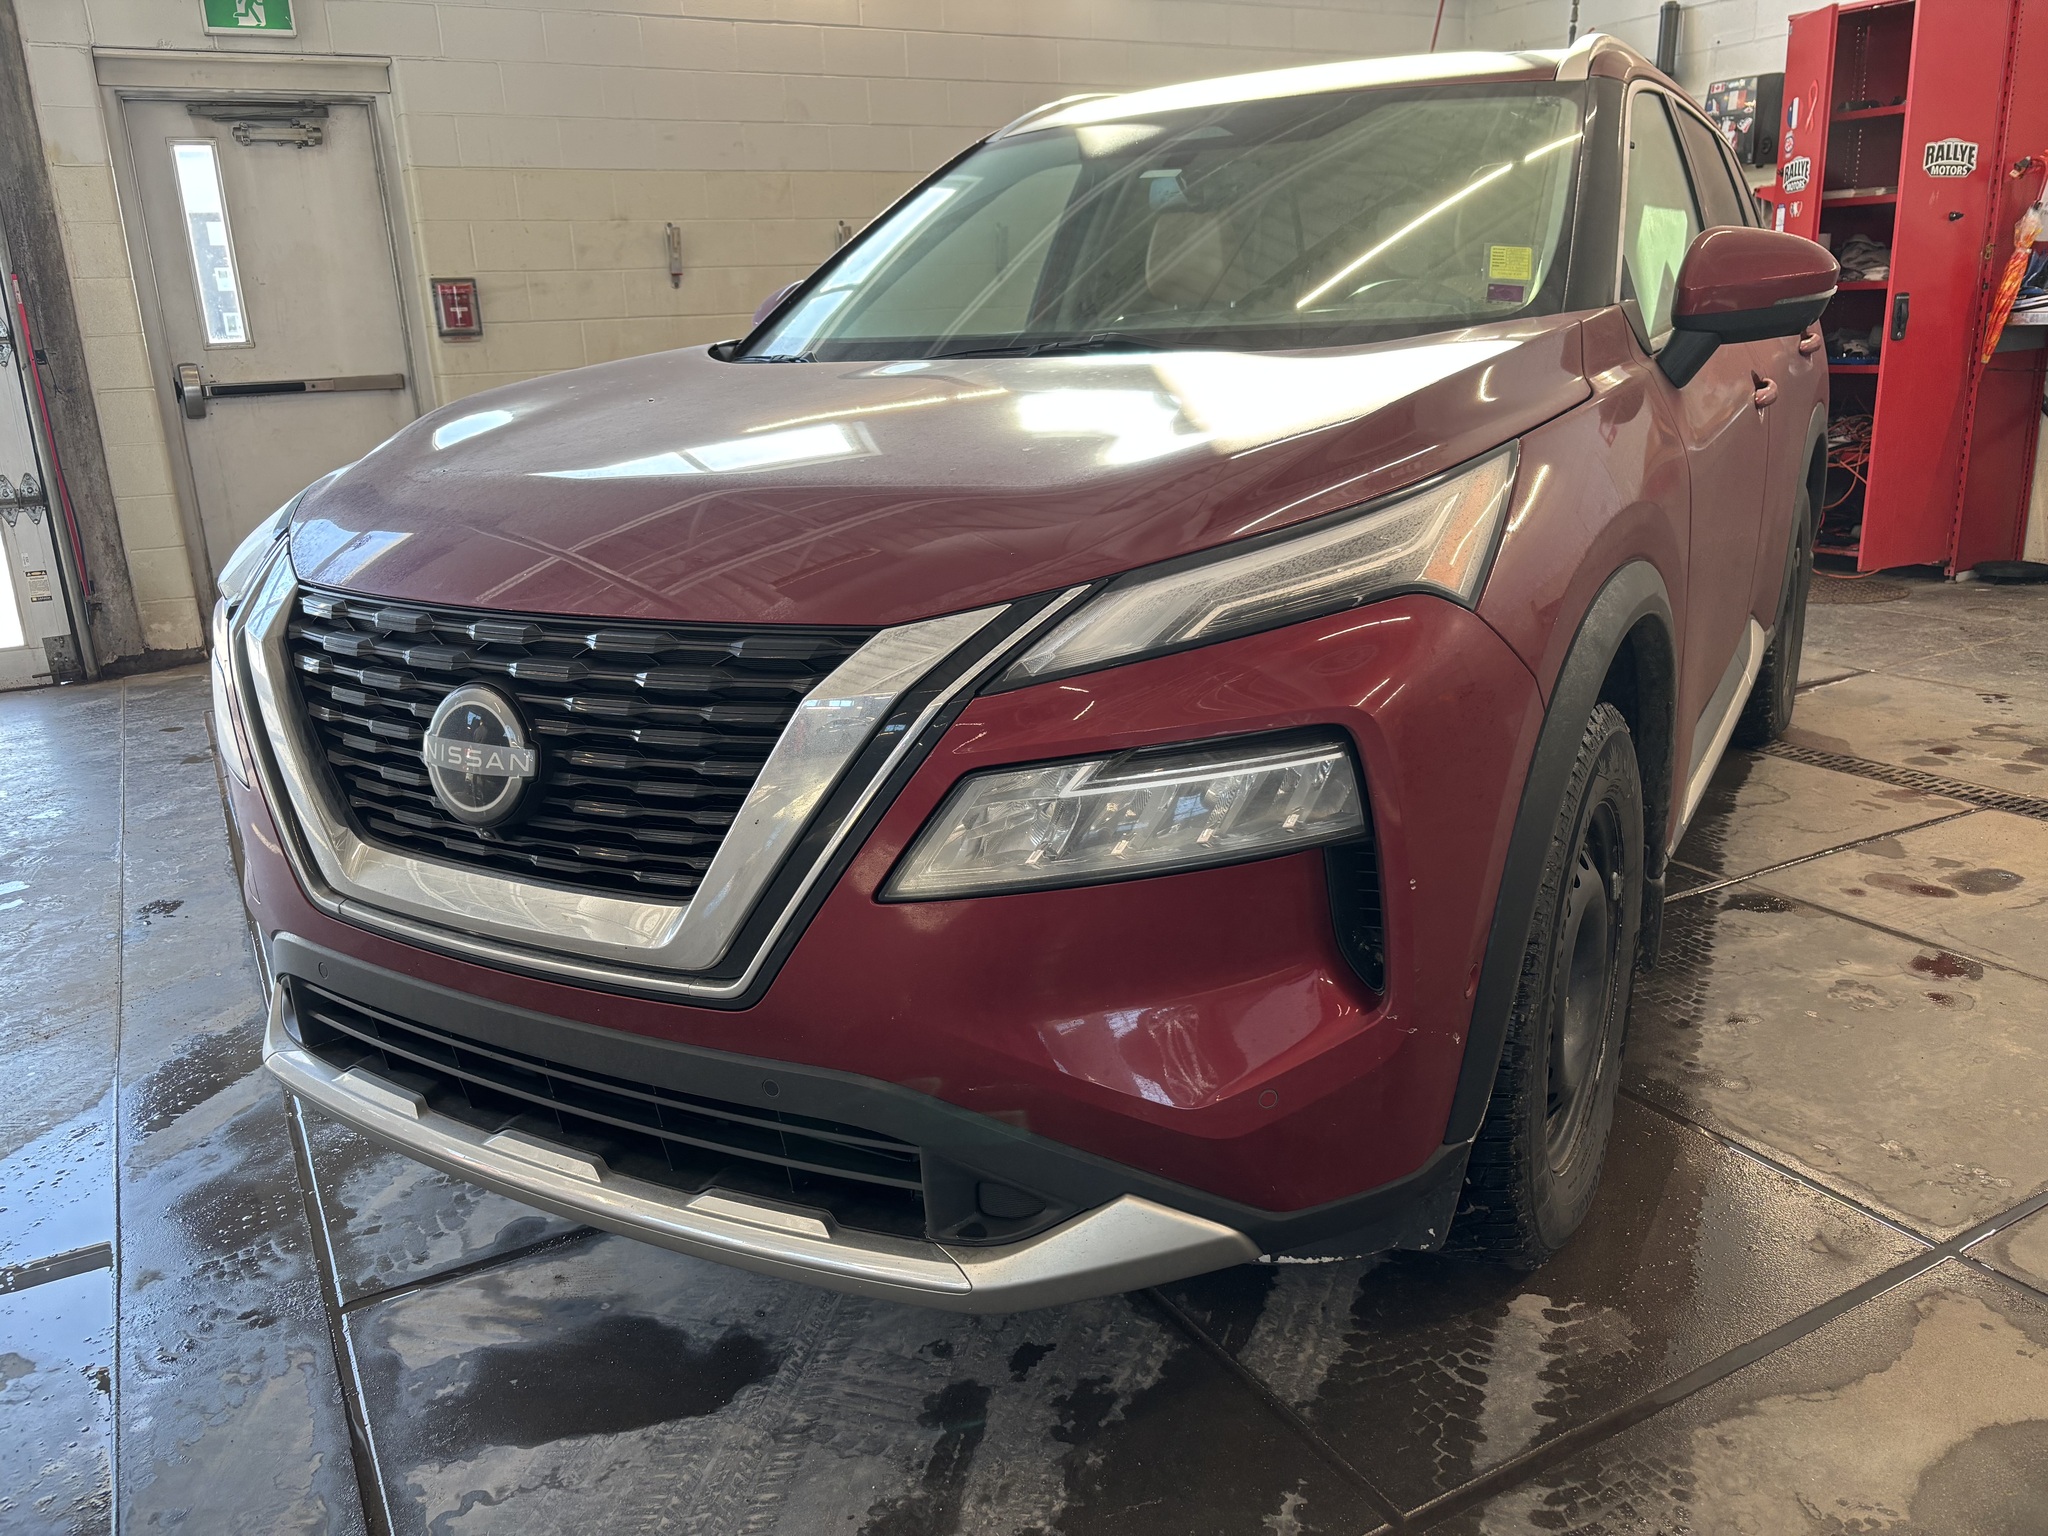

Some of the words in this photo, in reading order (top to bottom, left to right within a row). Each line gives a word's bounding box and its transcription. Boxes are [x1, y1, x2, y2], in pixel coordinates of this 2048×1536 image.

[1925, 144, 1976, 167] RALLYE
[1784, 161, 1809, 181] RALLYE
[1930, 165, 1968, 175] MOTORS
[426, 741, 530, 772] NISSAN
